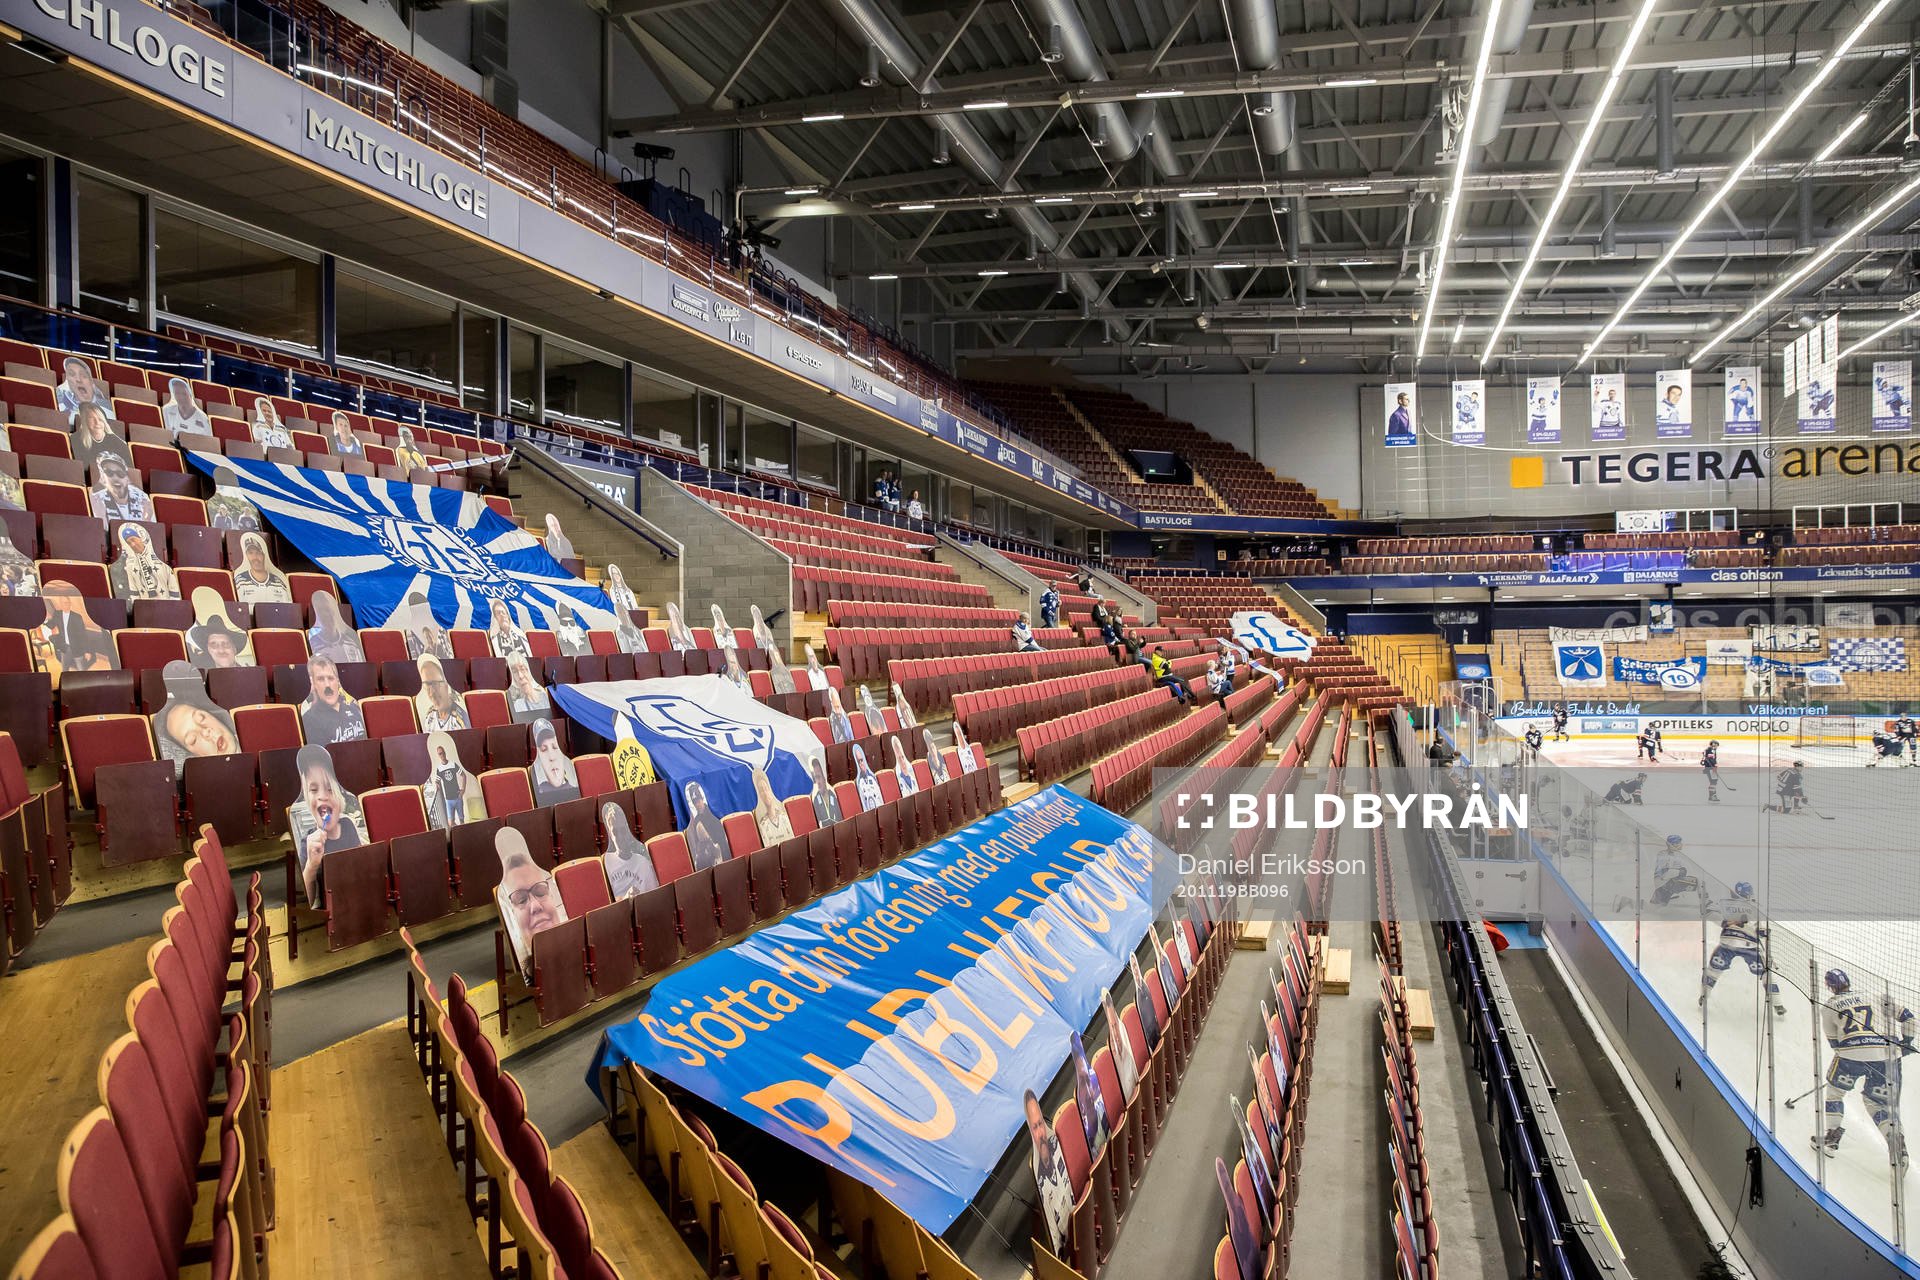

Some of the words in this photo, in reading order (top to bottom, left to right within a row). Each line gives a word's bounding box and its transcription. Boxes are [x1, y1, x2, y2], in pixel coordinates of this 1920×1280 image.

[306, 107, 488, 220] MATCHLOGE
[1145, 516, 1192, 526] BASTULOGE
[1635, 571, 1679, 579] DALARNAS
[1711, 569, 1738, 582] clas
[1740, 568, 1783, 582] ohlson
[1864, 566, 1911, 578] Sparbank
[1667, 674, 1688, 685] 19
[1748, 704, 1829, 715] Välkommen!
[1653, 719, 1713, 730] OPTILEKS
[638, 978, 805, 1067] Stötta
[772, 943, 862, 994] din
[821, 877, 974, 961] förening
[938, 843, 998, 892] med
[980, 837, 1020, 864] en
[1838, 1005, 1873, 1035] 27
